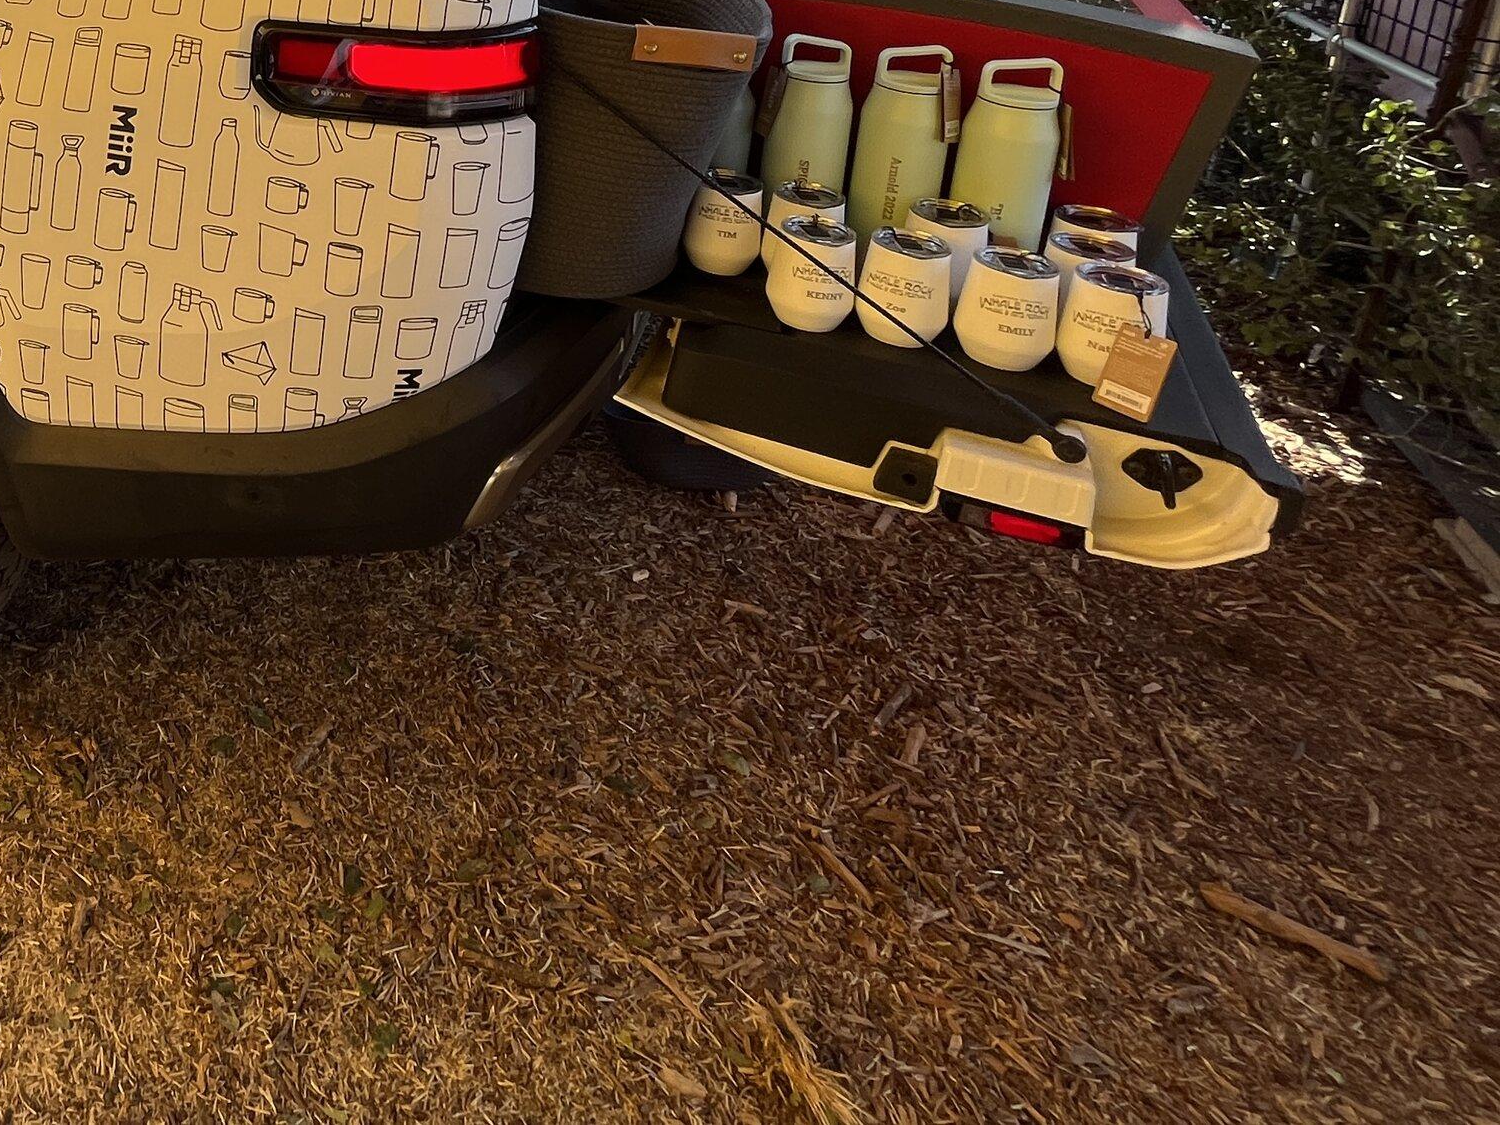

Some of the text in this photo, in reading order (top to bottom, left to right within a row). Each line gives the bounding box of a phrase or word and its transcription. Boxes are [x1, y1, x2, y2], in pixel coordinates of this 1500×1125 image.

[105, 105, 138, 177] MiiR
[882, 156, 903, 221] Arnold 2022
[716, 229, 737, 239] TIM
[806, 290, 844, 301] KENNY
[885, 302, 907, 314] Zoe
[998, 323, 1037, 337] EMILY
[1086, 339, 1112, 353] Nat
